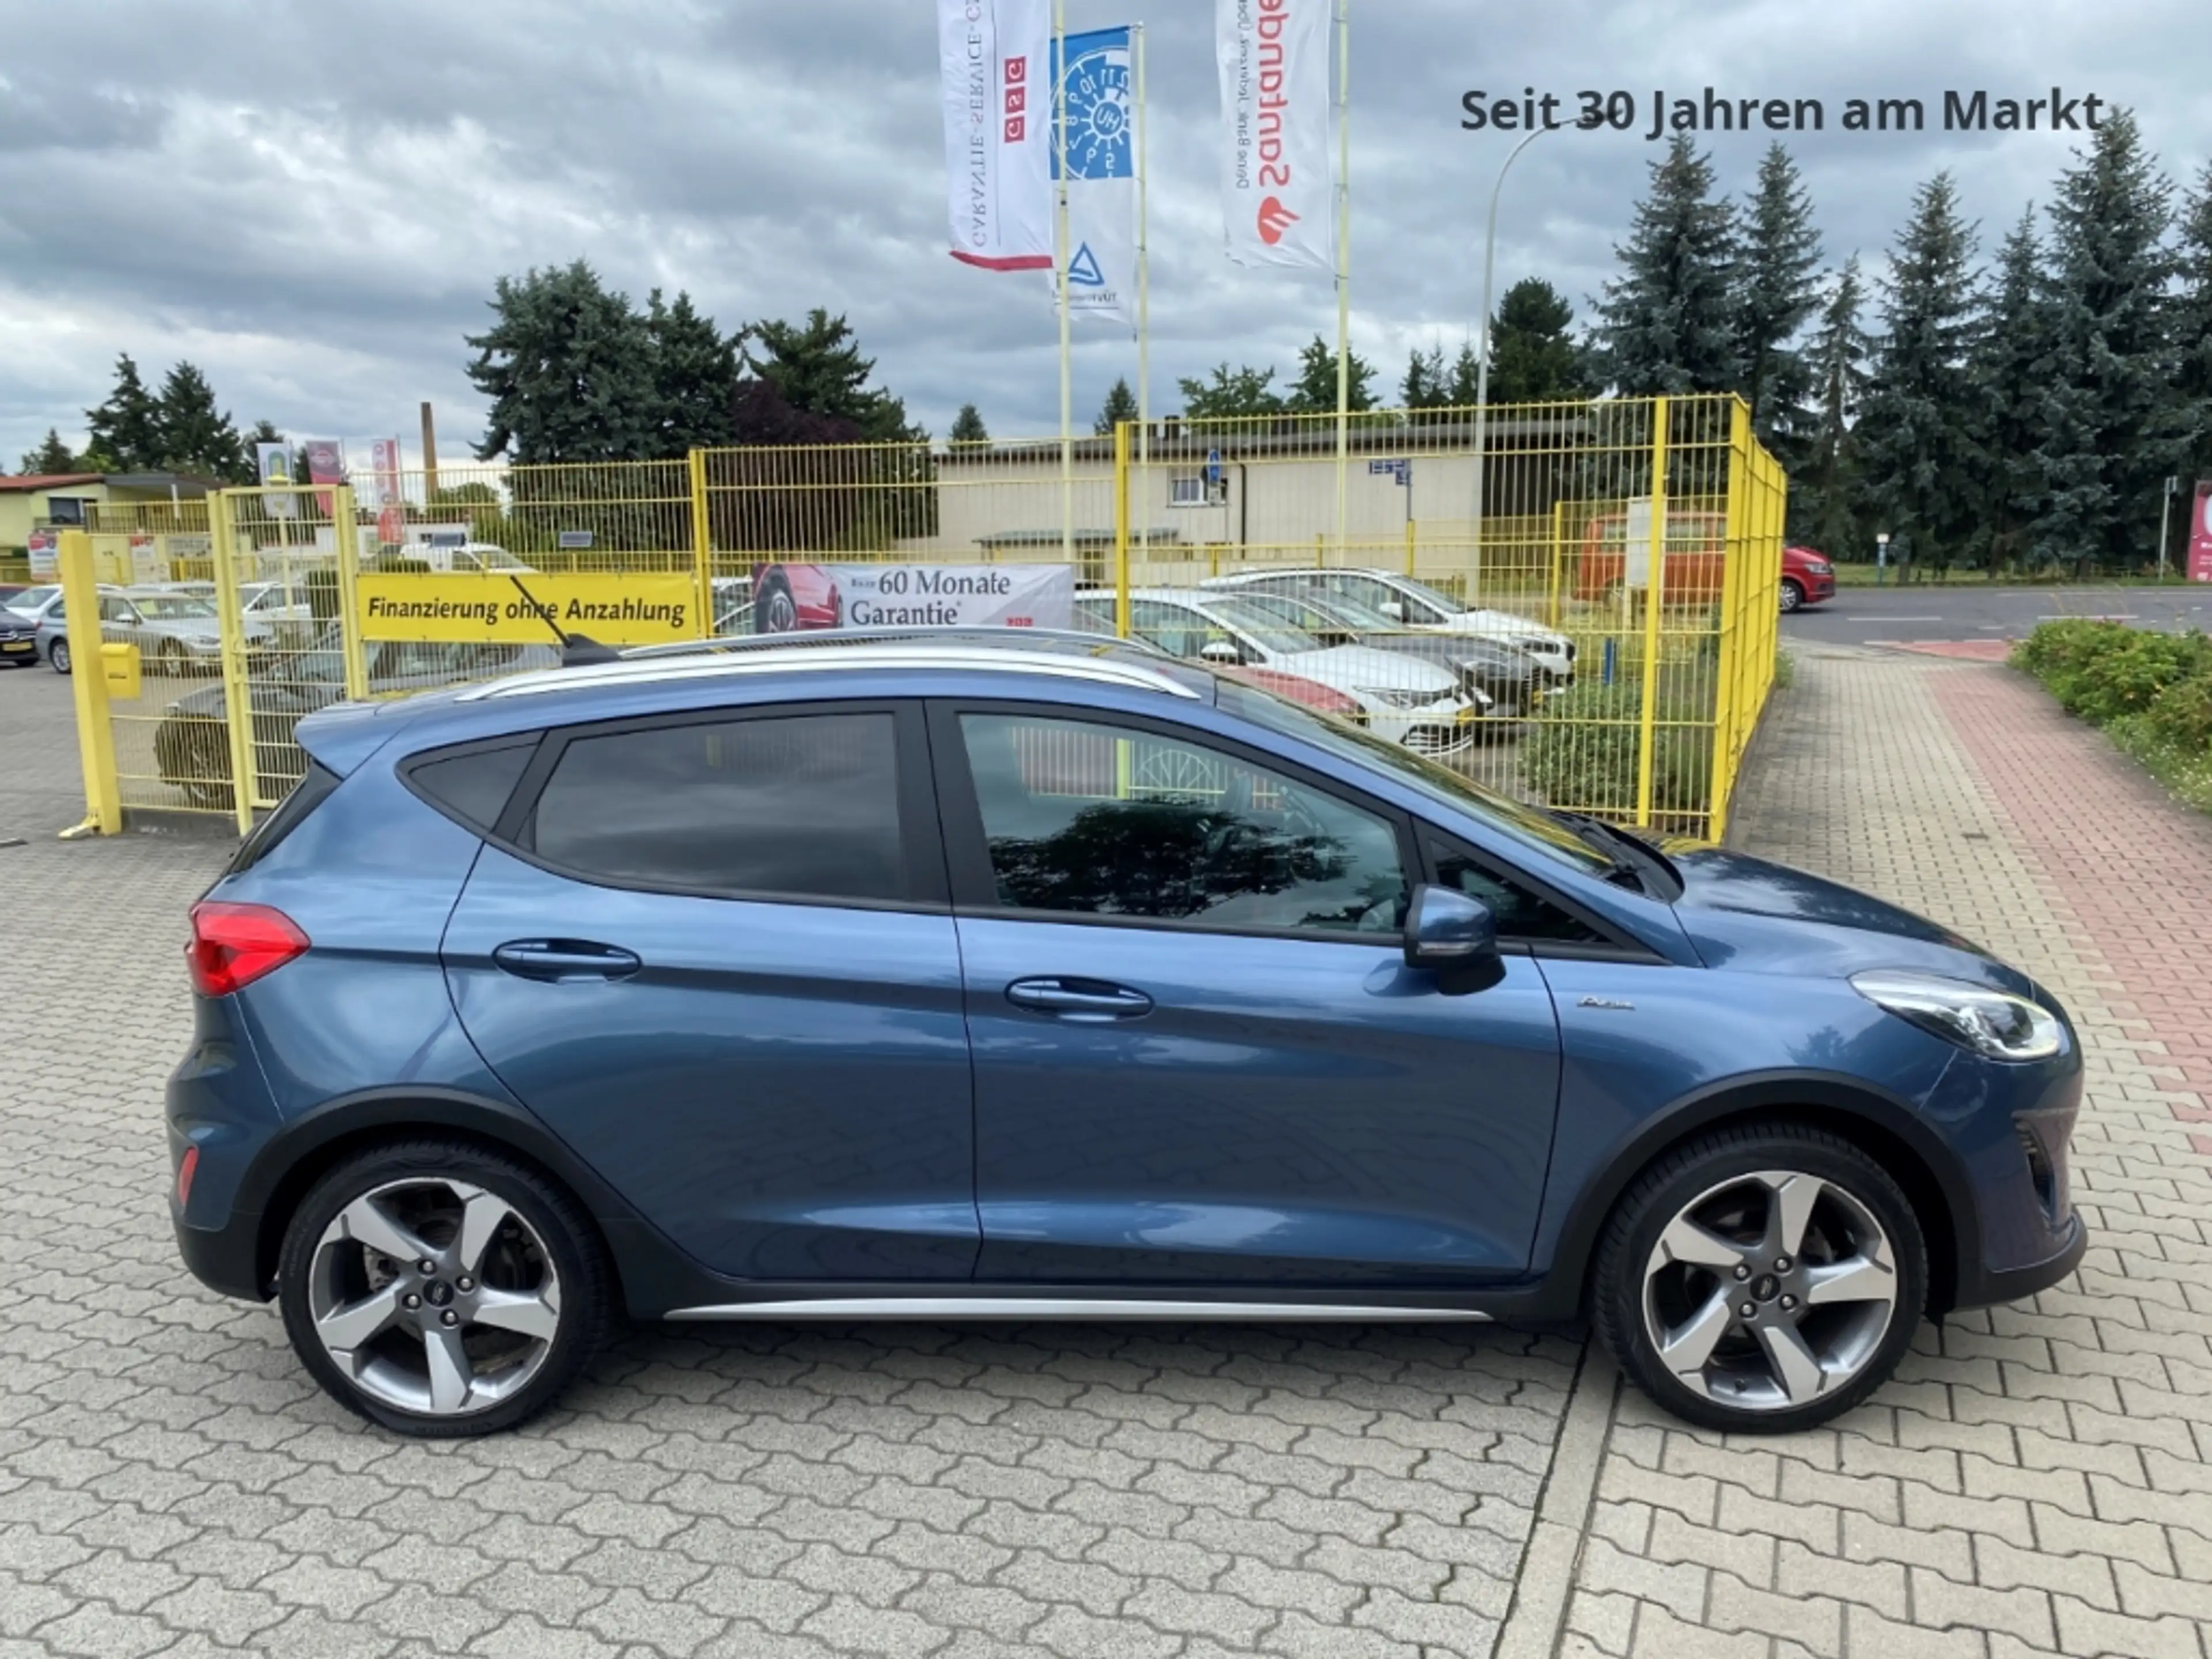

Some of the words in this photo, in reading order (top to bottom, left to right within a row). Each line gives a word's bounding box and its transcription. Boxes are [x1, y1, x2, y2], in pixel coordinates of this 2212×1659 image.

[878, 569, 908, 596] 60
[915, 569, 1012, 596] Monate
[368, 597, 499, 625] Finanzierung
[505, 597, 558, 620] ohne
[565, 597, 685, 628] Anzahlung
